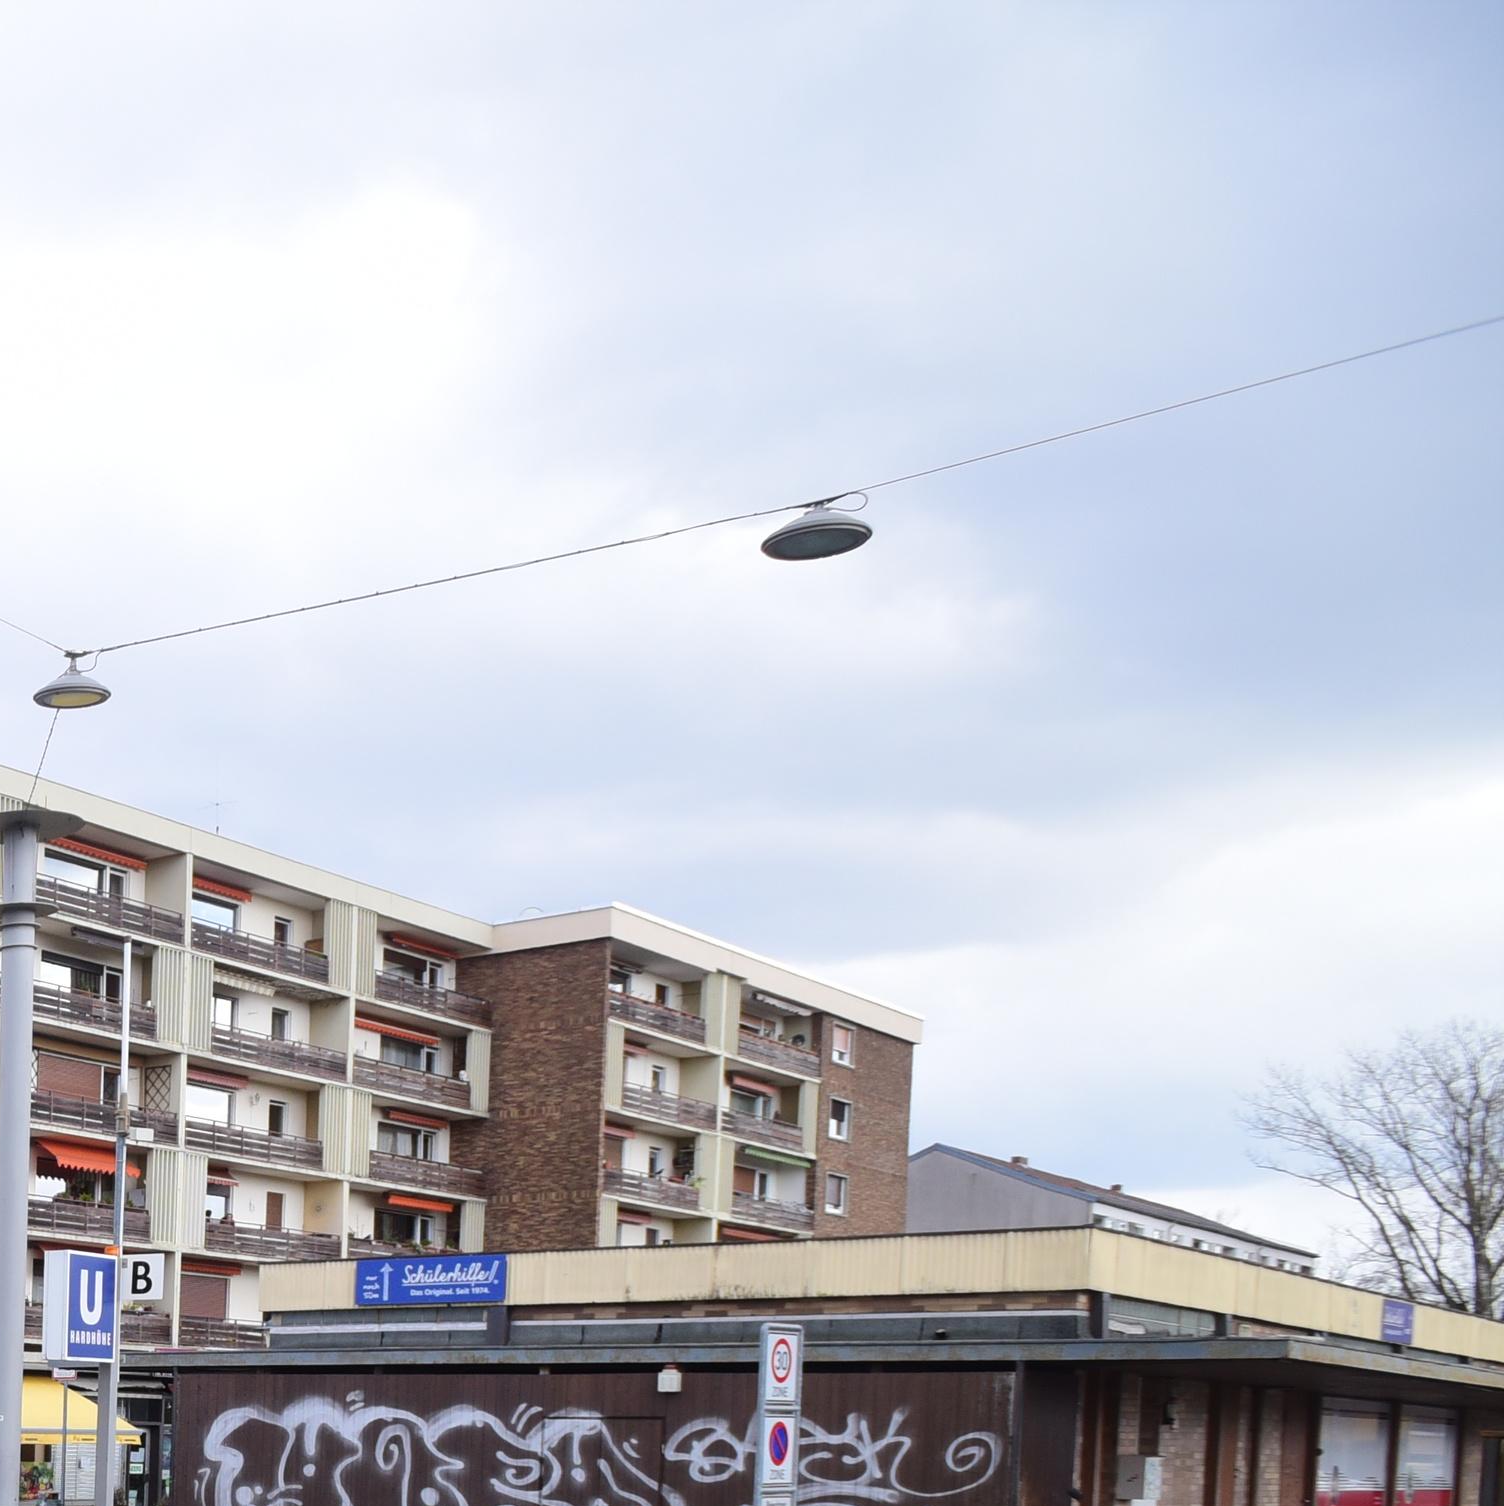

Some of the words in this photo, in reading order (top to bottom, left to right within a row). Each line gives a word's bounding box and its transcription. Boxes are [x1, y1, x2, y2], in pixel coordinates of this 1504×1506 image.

[131, 1261, 152, 1294] B
[80, 1269, 103, 1325] U
[70, 1329, 111, 1346] HARDHÖHE
